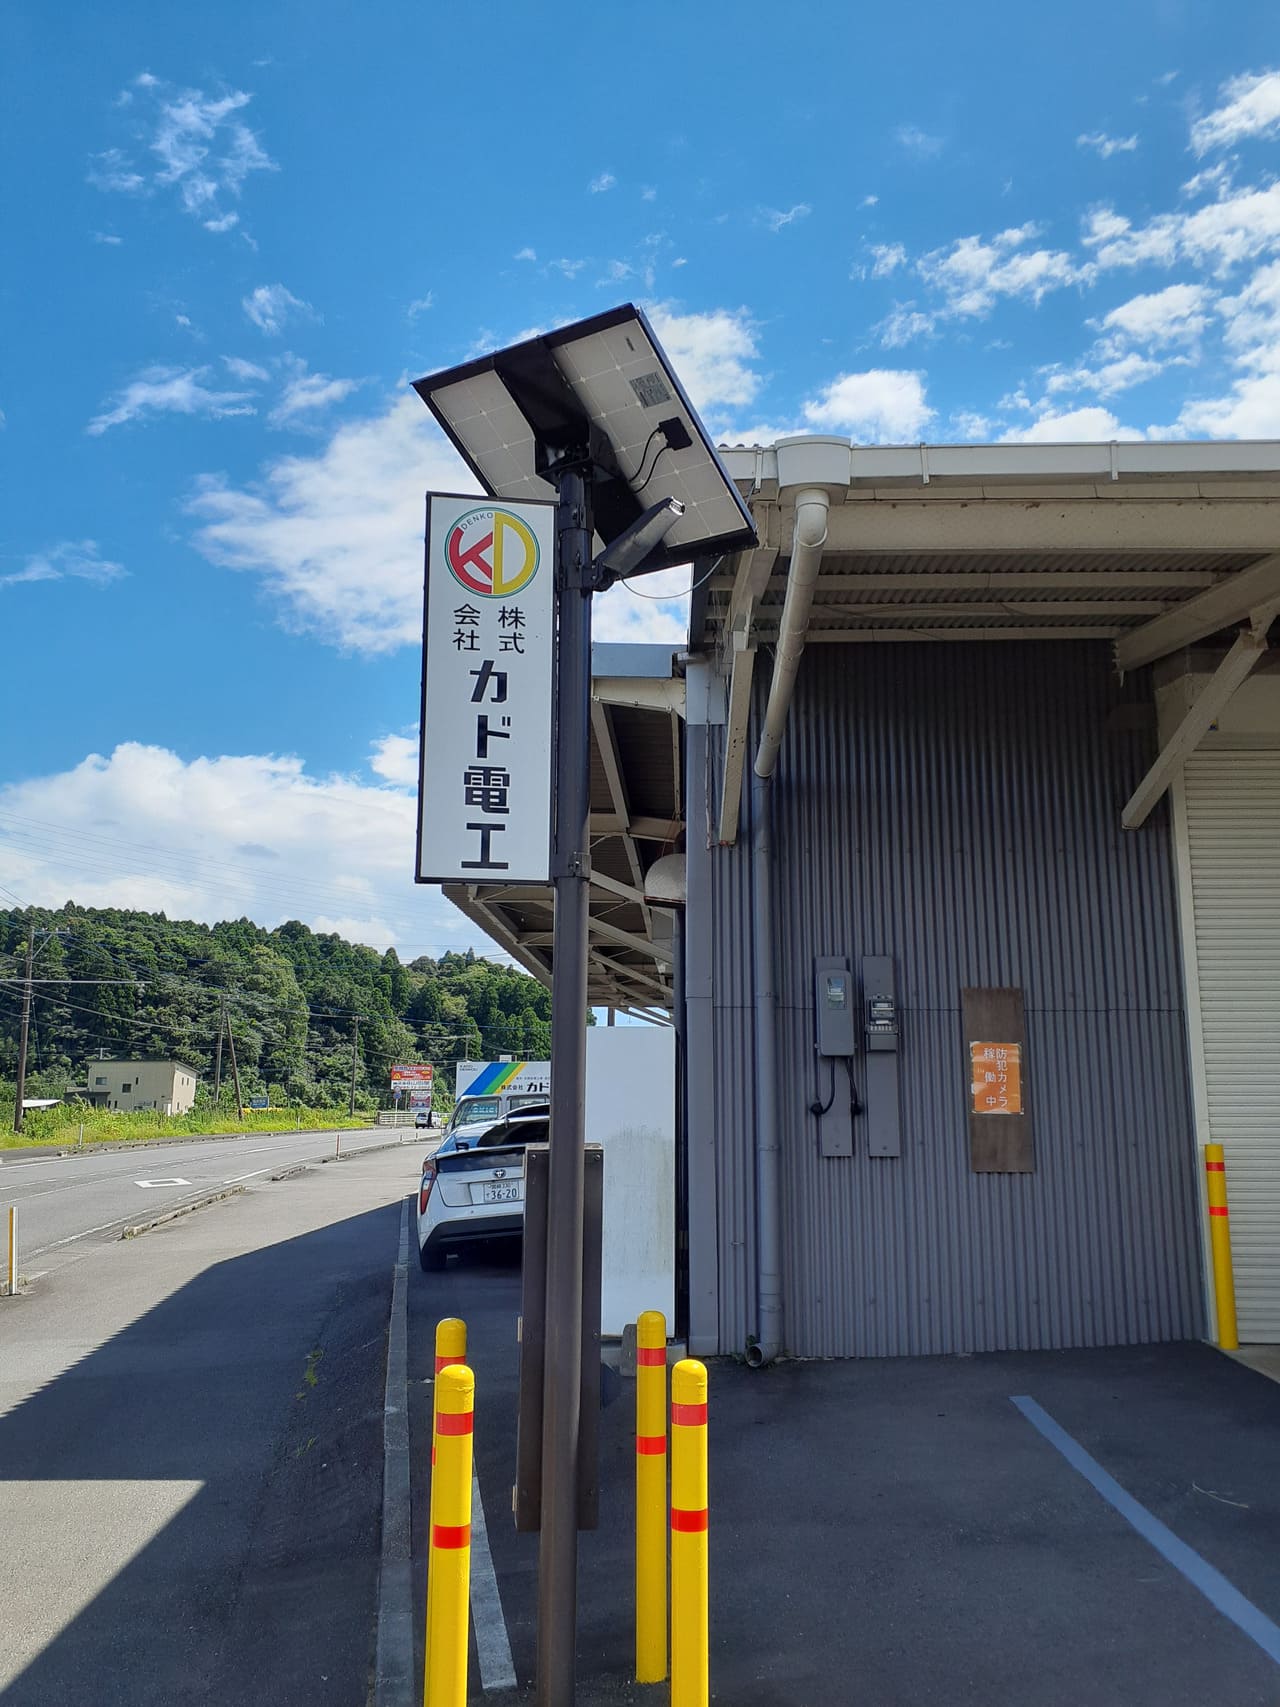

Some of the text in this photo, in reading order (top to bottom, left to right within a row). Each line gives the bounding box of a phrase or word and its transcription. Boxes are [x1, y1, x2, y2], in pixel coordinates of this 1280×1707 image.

[460, 511, 494, 531] DENKO
[452, 603, 480, 651] 会社
[498, 605, 526, 654] 株式
[460, 659, 511, 870] カド電工
[995, 1047, 1008, 1108] 防犯カメラ
[491, 1188, 517, 1200] 36-20
